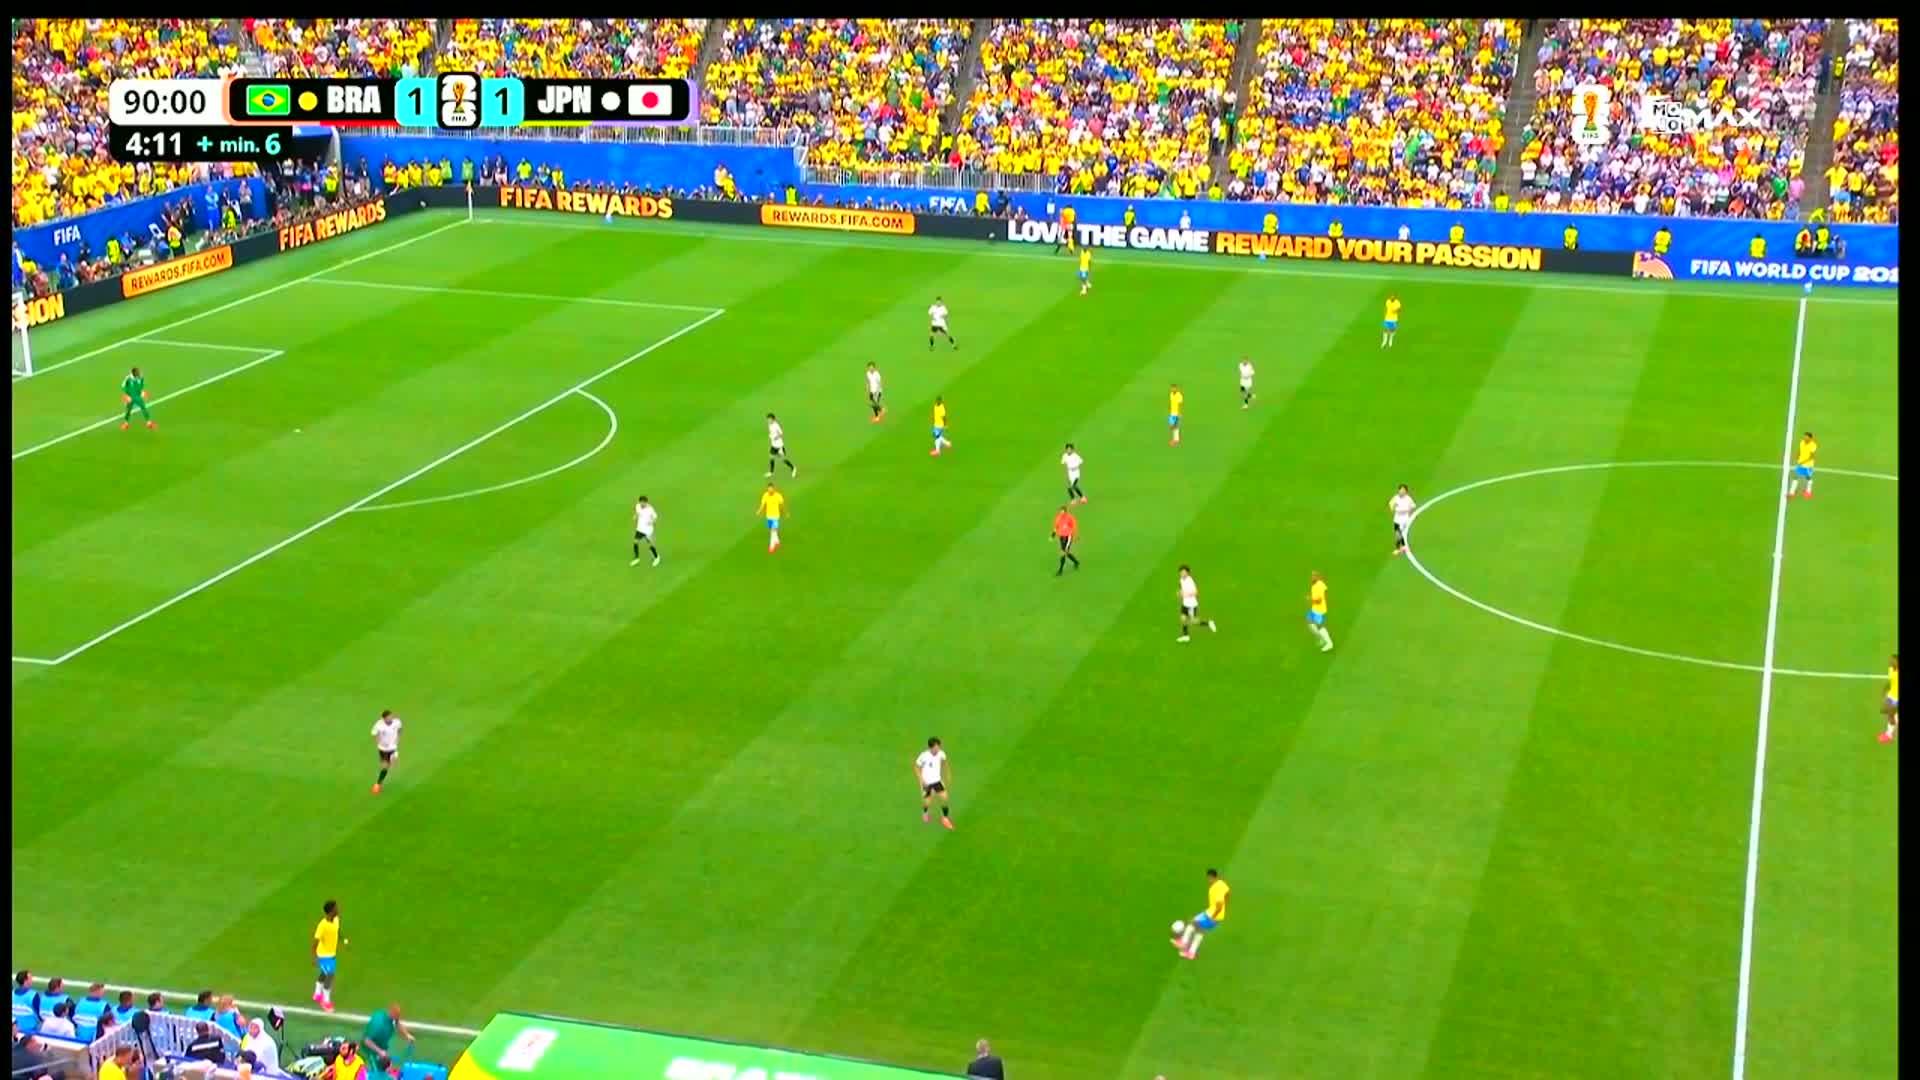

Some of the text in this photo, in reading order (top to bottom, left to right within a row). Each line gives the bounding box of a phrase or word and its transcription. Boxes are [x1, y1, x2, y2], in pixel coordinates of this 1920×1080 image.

[500, 186, 673, 219] FIFA REWARDS
[53, 224, 81, 247] FIFA
[280, 199, 386, 252] FIFA REWARDS
[772, 210, 904, 229] REWARDS.FIFA.COM
[1008, 220, 1542, 271] LOV THE GAME REWARD YOUR PASSION
[131, 253, 226, 290] REWARDS.FIFA.COM
[1690, 259, 1732, 276] FIFA
[1735, 262, 1806, 279] WORLD
[1809, 264, 1850, 281] CUP
